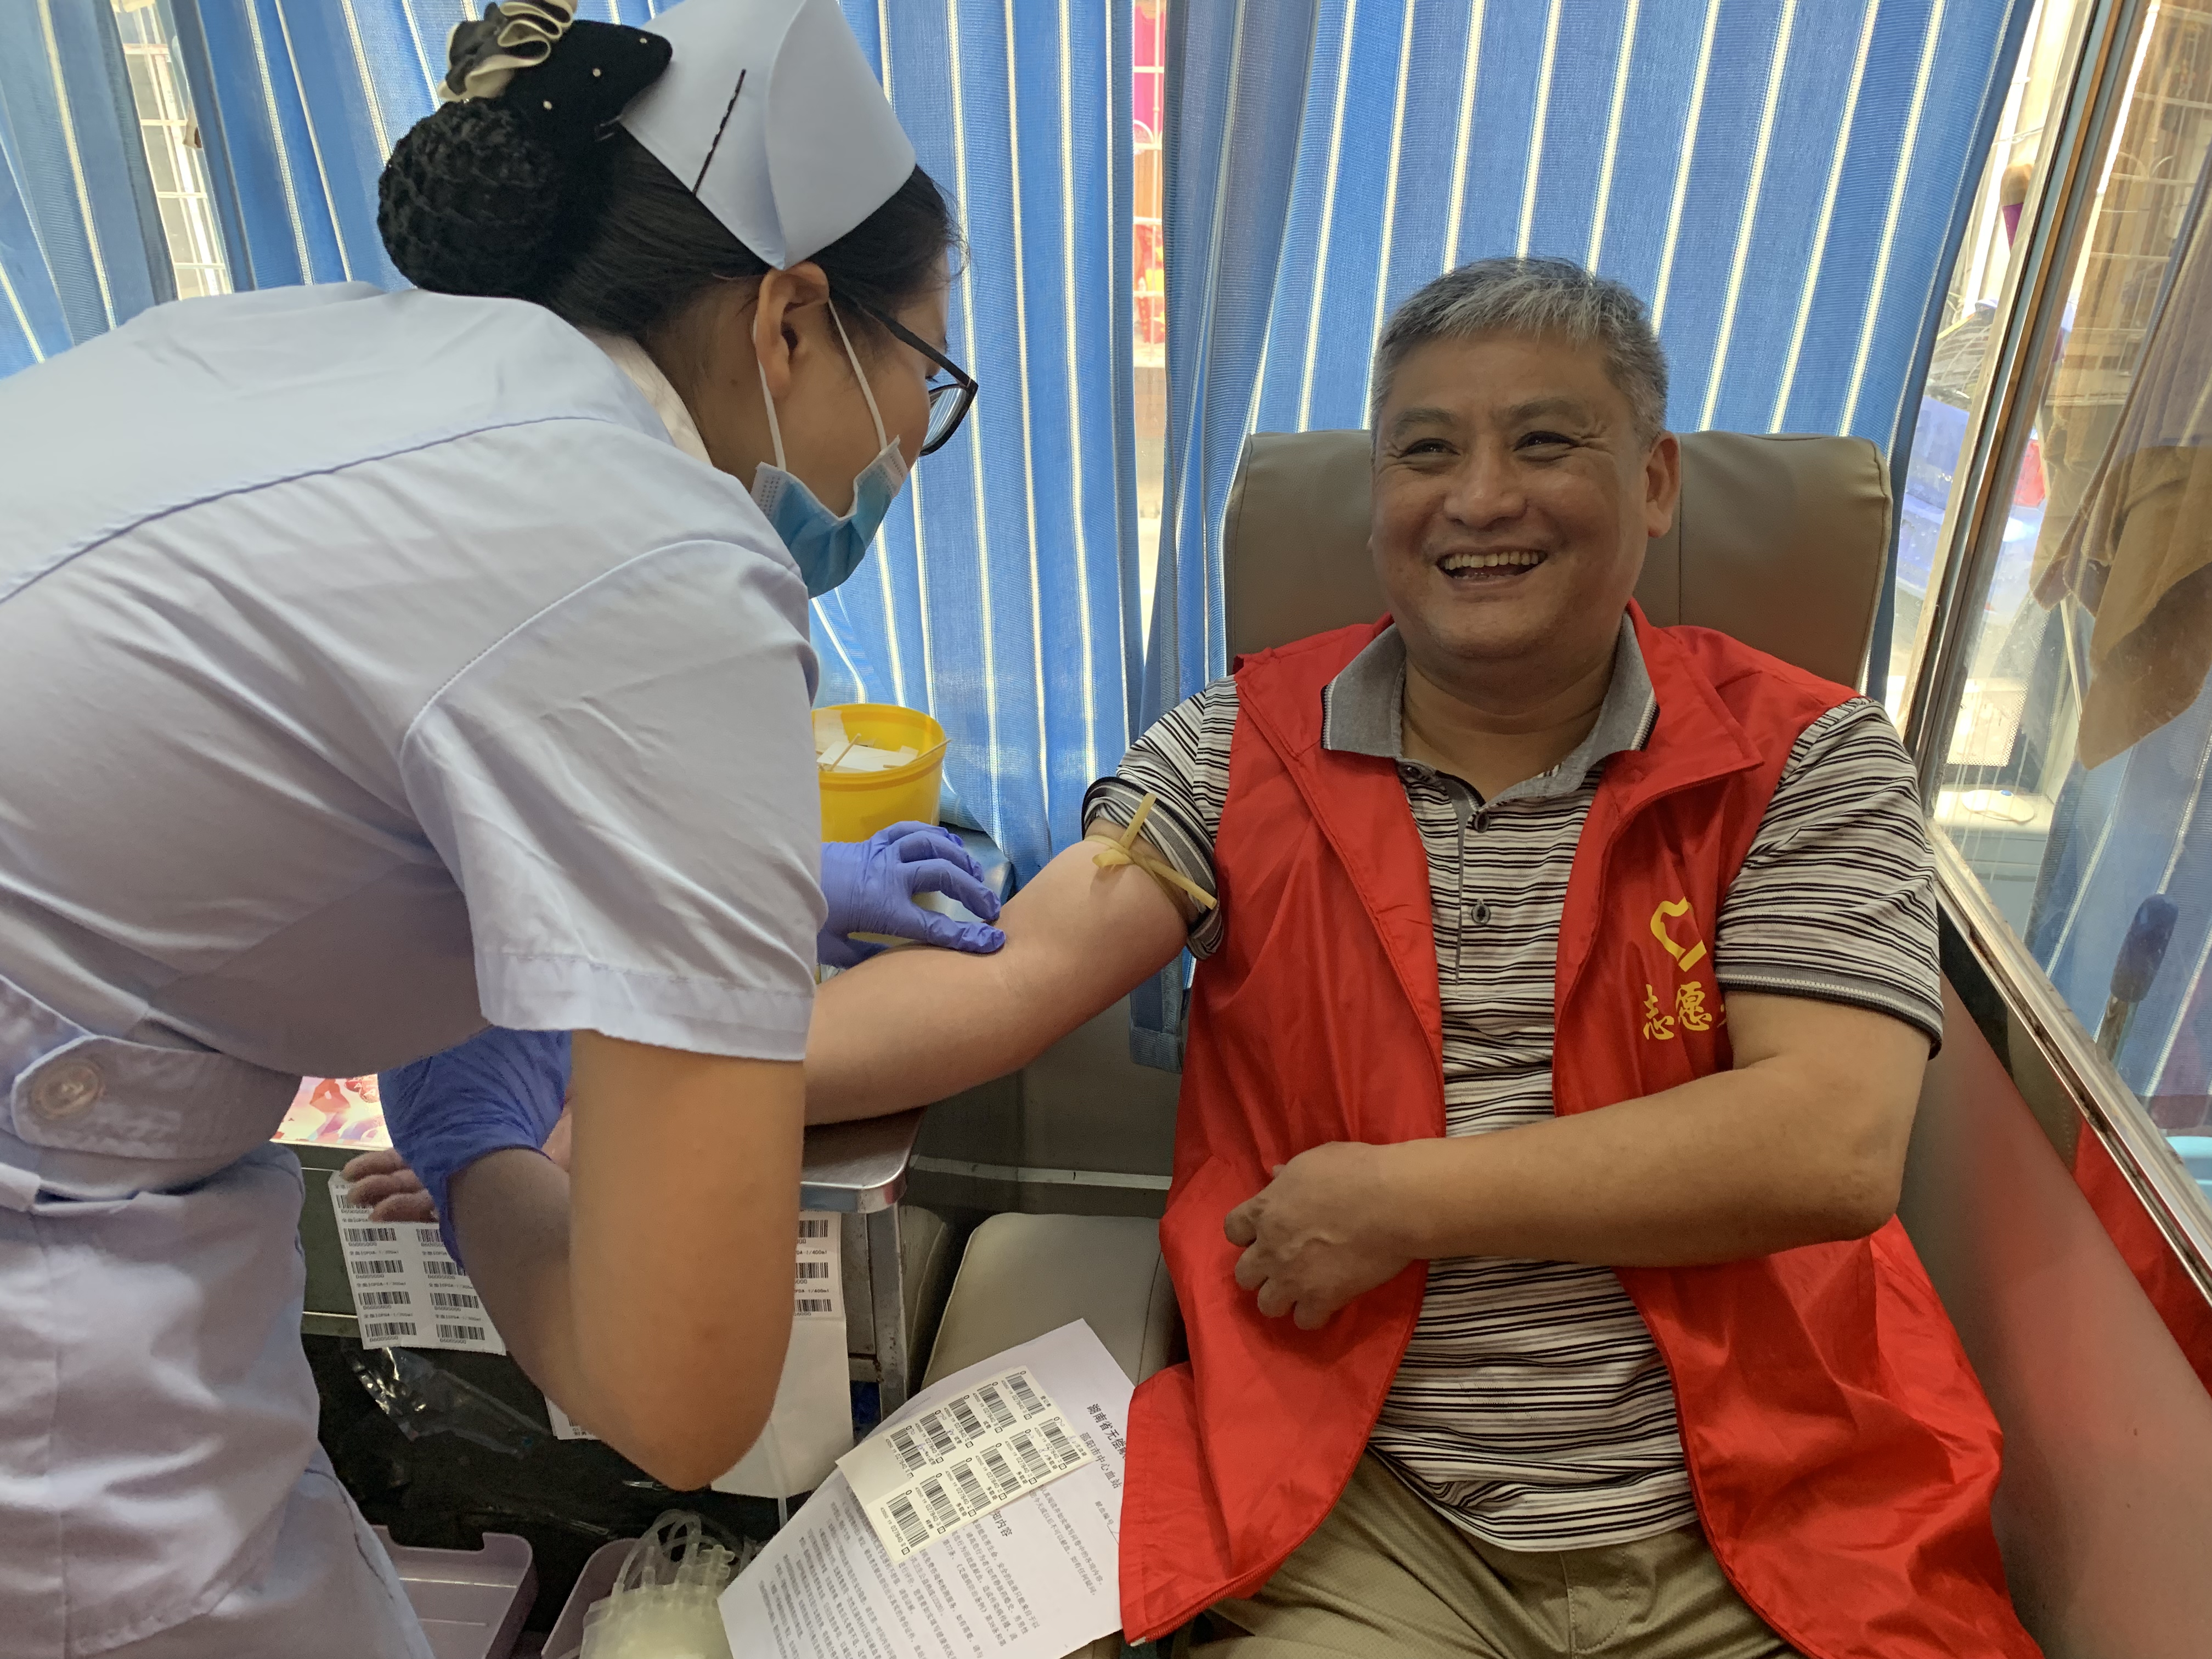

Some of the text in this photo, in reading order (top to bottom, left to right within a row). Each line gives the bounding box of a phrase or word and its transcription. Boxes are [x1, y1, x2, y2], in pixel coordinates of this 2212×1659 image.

[1643, 981, 1726, 1040] 志愿
[1012, 1395, 1025, 1409] 027840
[984, 1407, 996, 1423] 027840
[955, 1422, 967, 1438] 027840
[925, 1437, 938, 1453] 027840
[1046, 1443, 1059, 1459] 027840
[896, 1453, 907, 1469] 027840
[1017, 1457, 1030, 1473] 027840
[987, 1471, 1000, 1488] 027840
[956, 1487, 969, 1504] 027840
[926, 1504, 939, 1521] 027840
[891, 1525, 904, 1542] 027840
